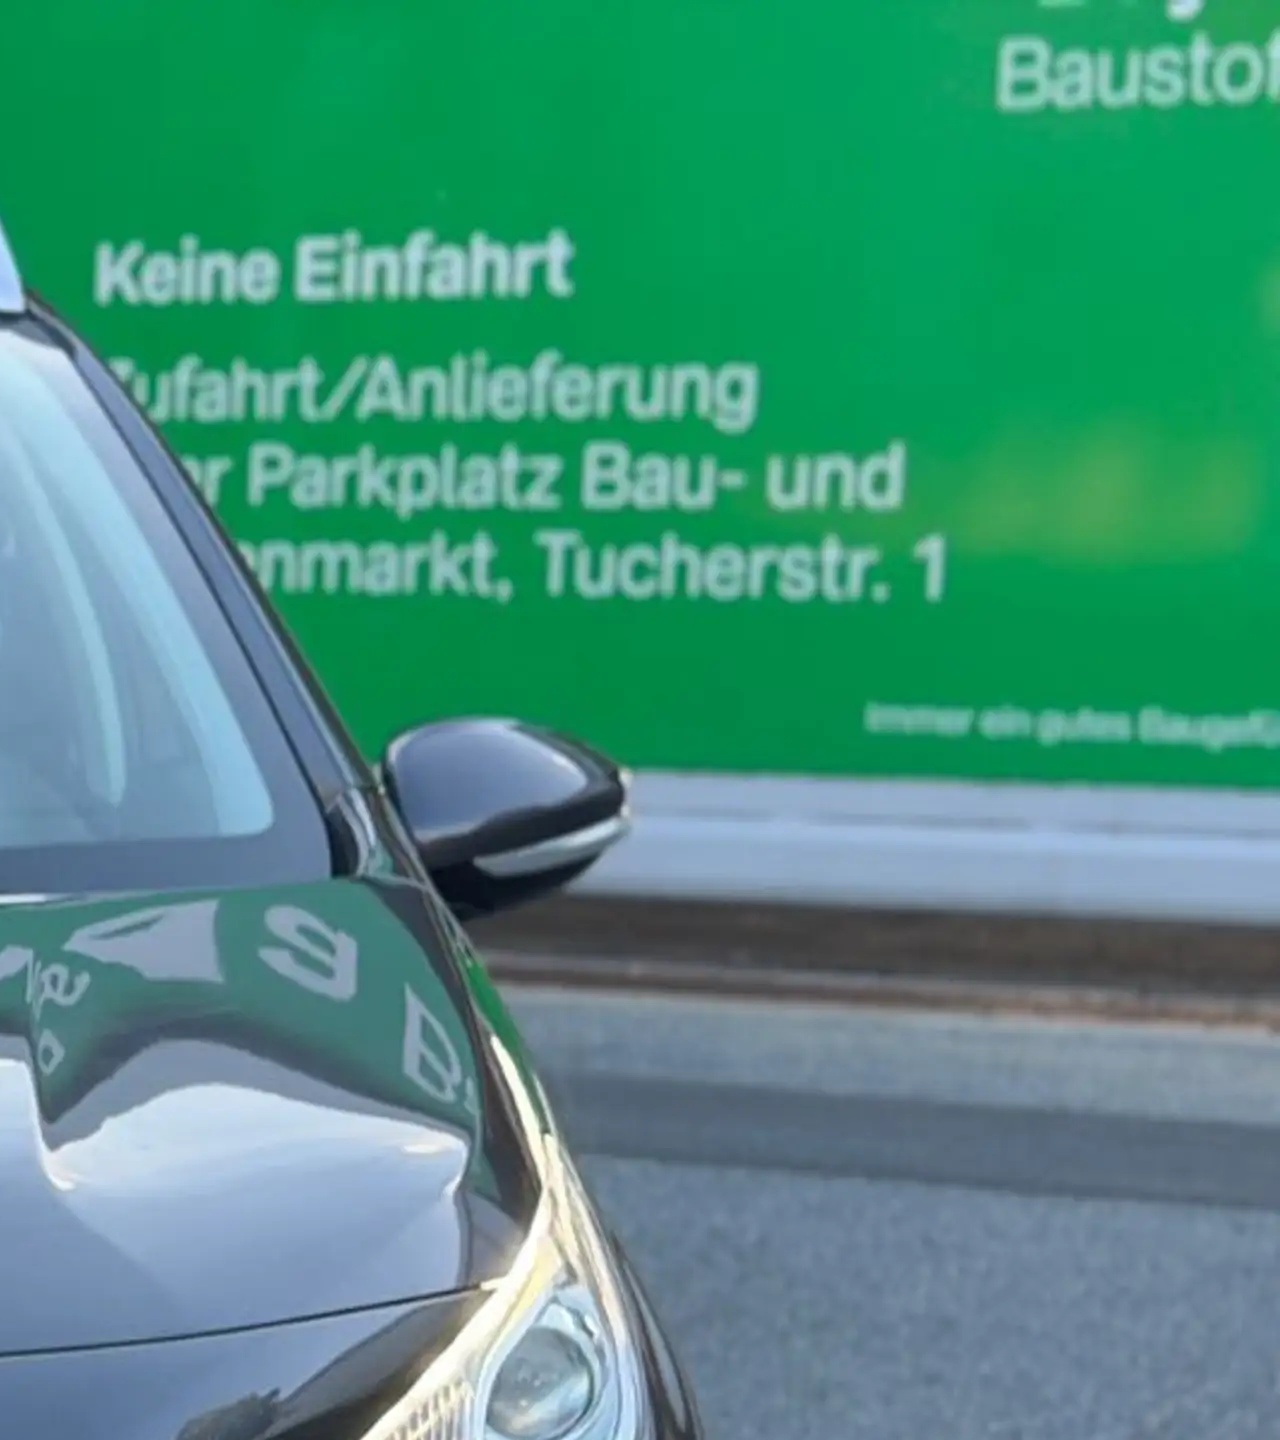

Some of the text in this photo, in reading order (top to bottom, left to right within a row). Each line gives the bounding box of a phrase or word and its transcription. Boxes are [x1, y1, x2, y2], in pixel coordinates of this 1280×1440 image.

[94, 228, 575, 305] Keine Einfahrt
[247, 441, 564, 520] Parkplatz
[580, 440, 748, 511] Bau-
[765, 439, 908, 512] und
[535, 530, 891, 602] Tucherstr.
[912, 533, 948, 602] 1
